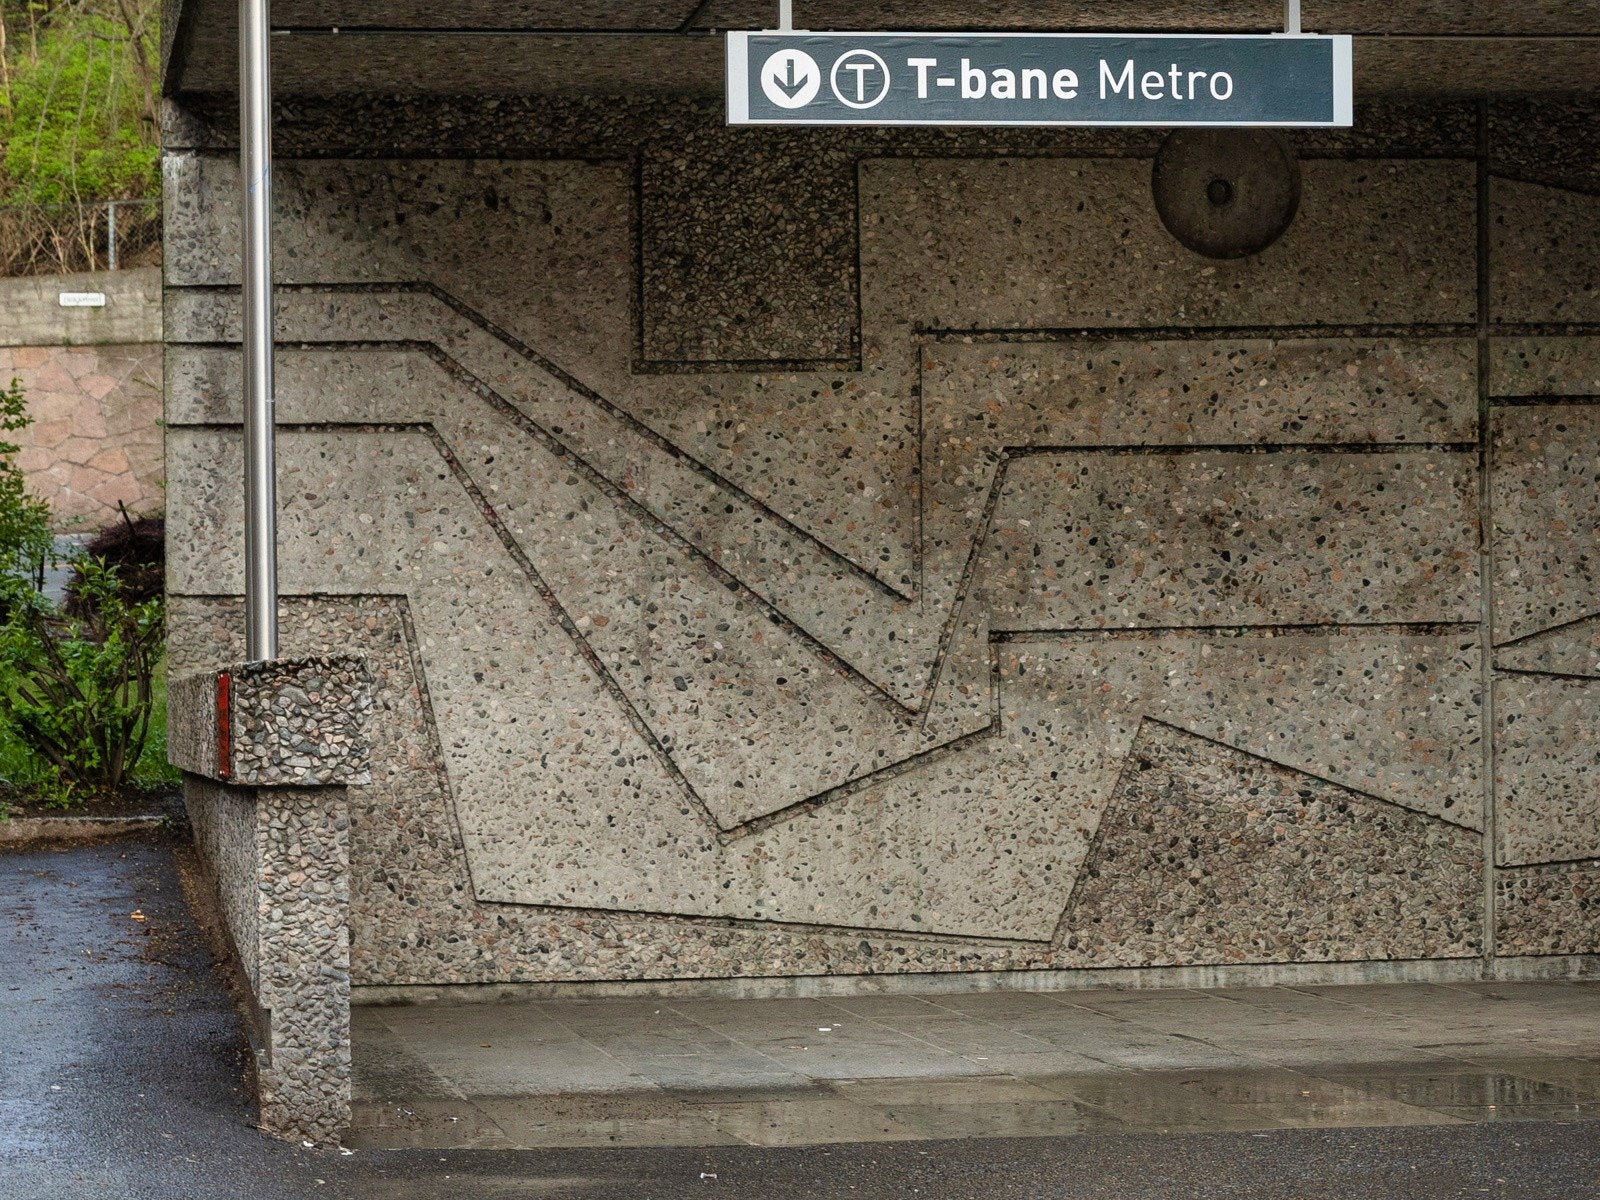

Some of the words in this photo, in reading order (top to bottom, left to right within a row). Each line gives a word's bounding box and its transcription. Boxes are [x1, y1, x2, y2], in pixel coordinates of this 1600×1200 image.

[845, 63, 875, 102] T
[907, 57, 1079, 100] T-bane
[1099, 59, 1234, 101] Metro
